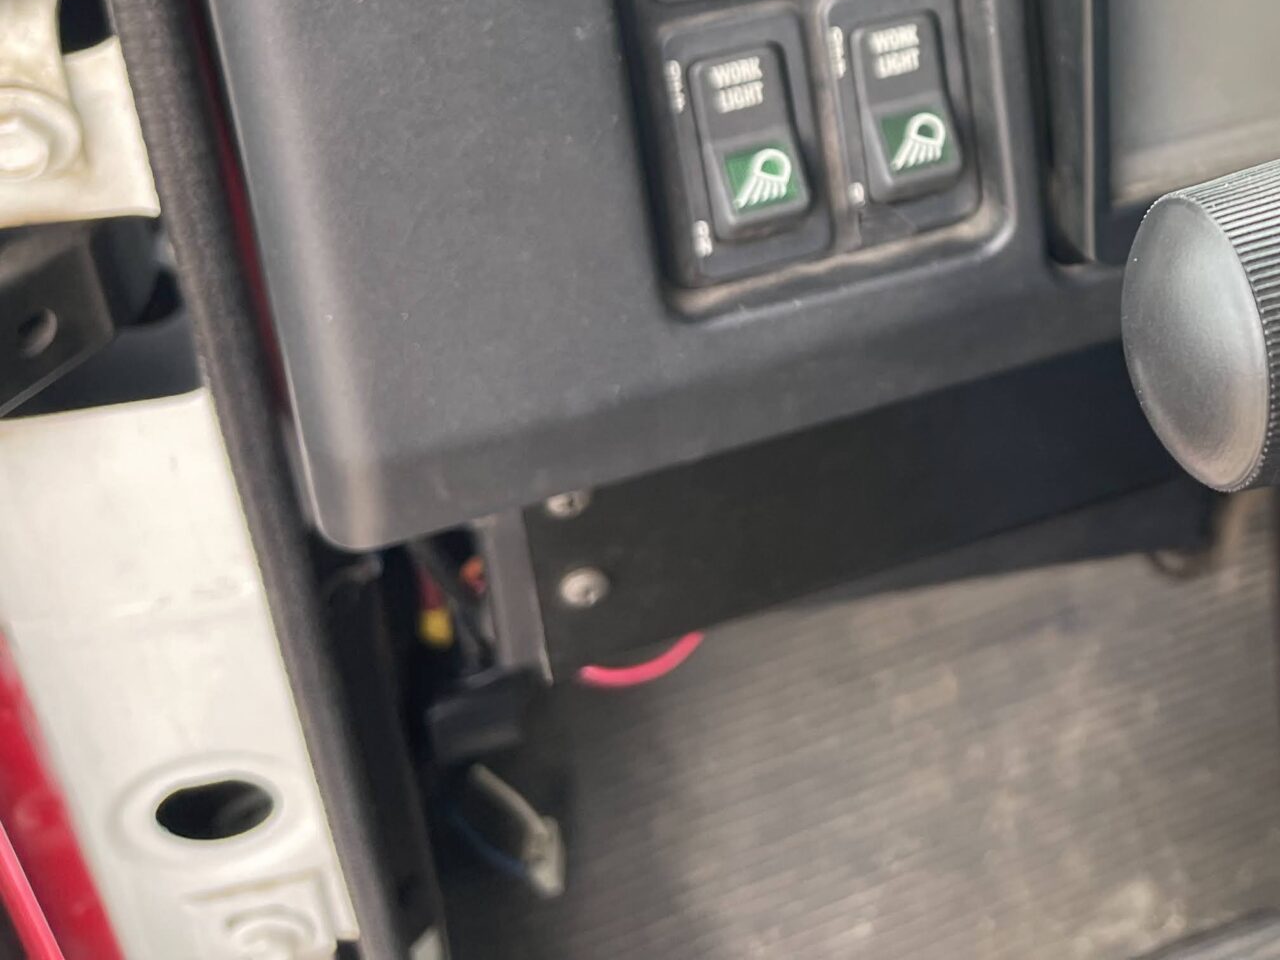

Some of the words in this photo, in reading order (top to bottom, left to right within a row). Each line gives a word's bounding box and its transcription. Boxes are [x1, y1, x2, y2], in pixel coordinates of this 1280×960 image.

[869, 23, 920, 55] WORK
[708, 56, 763, 89] WORK
[874, 47, 921, 79] LIGHT
[714, 80, 764, 114] LIGHT
